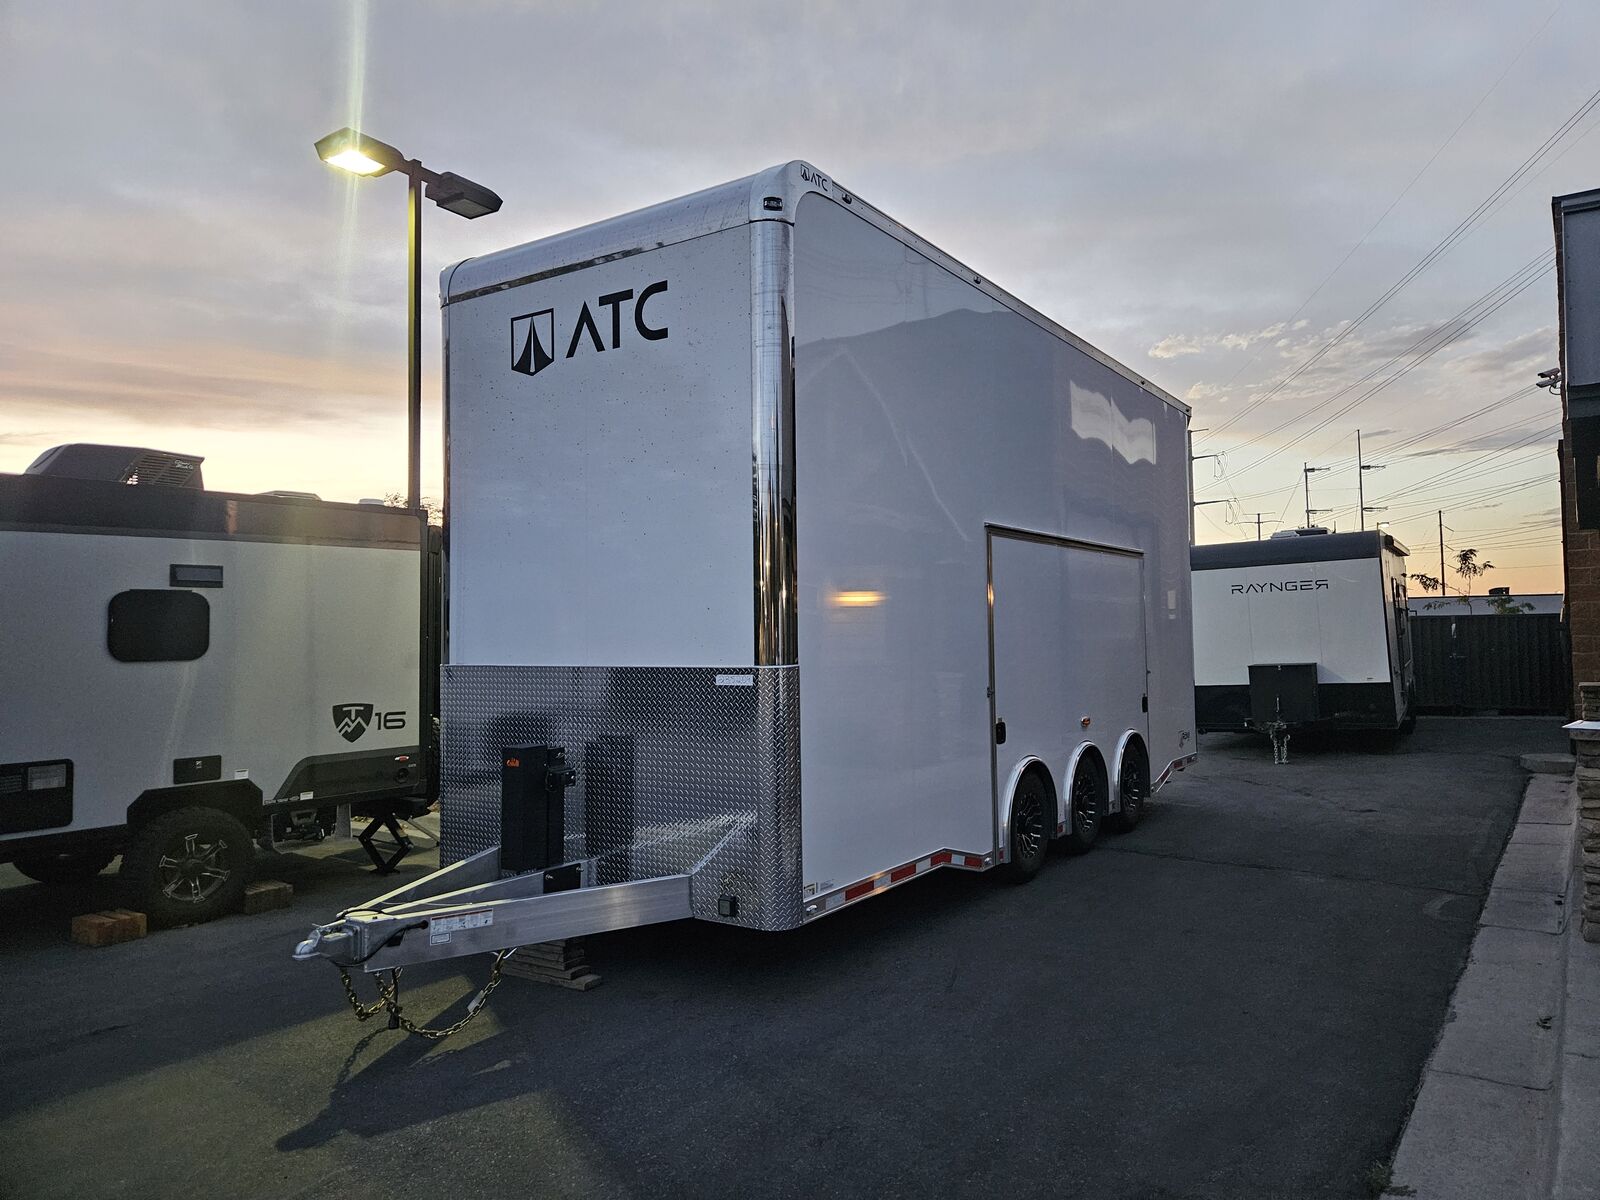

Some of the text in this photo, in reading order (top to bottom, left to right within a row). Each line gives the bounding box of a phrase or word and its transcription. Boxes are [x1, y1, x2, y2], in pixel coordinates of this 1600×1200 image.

[810, 172, 828, 191] ATC
[565, 280, 669, 359] ATC
[1231, 579, 1329, 594] RAYNGER
[374, 711, 407, 731] 16
